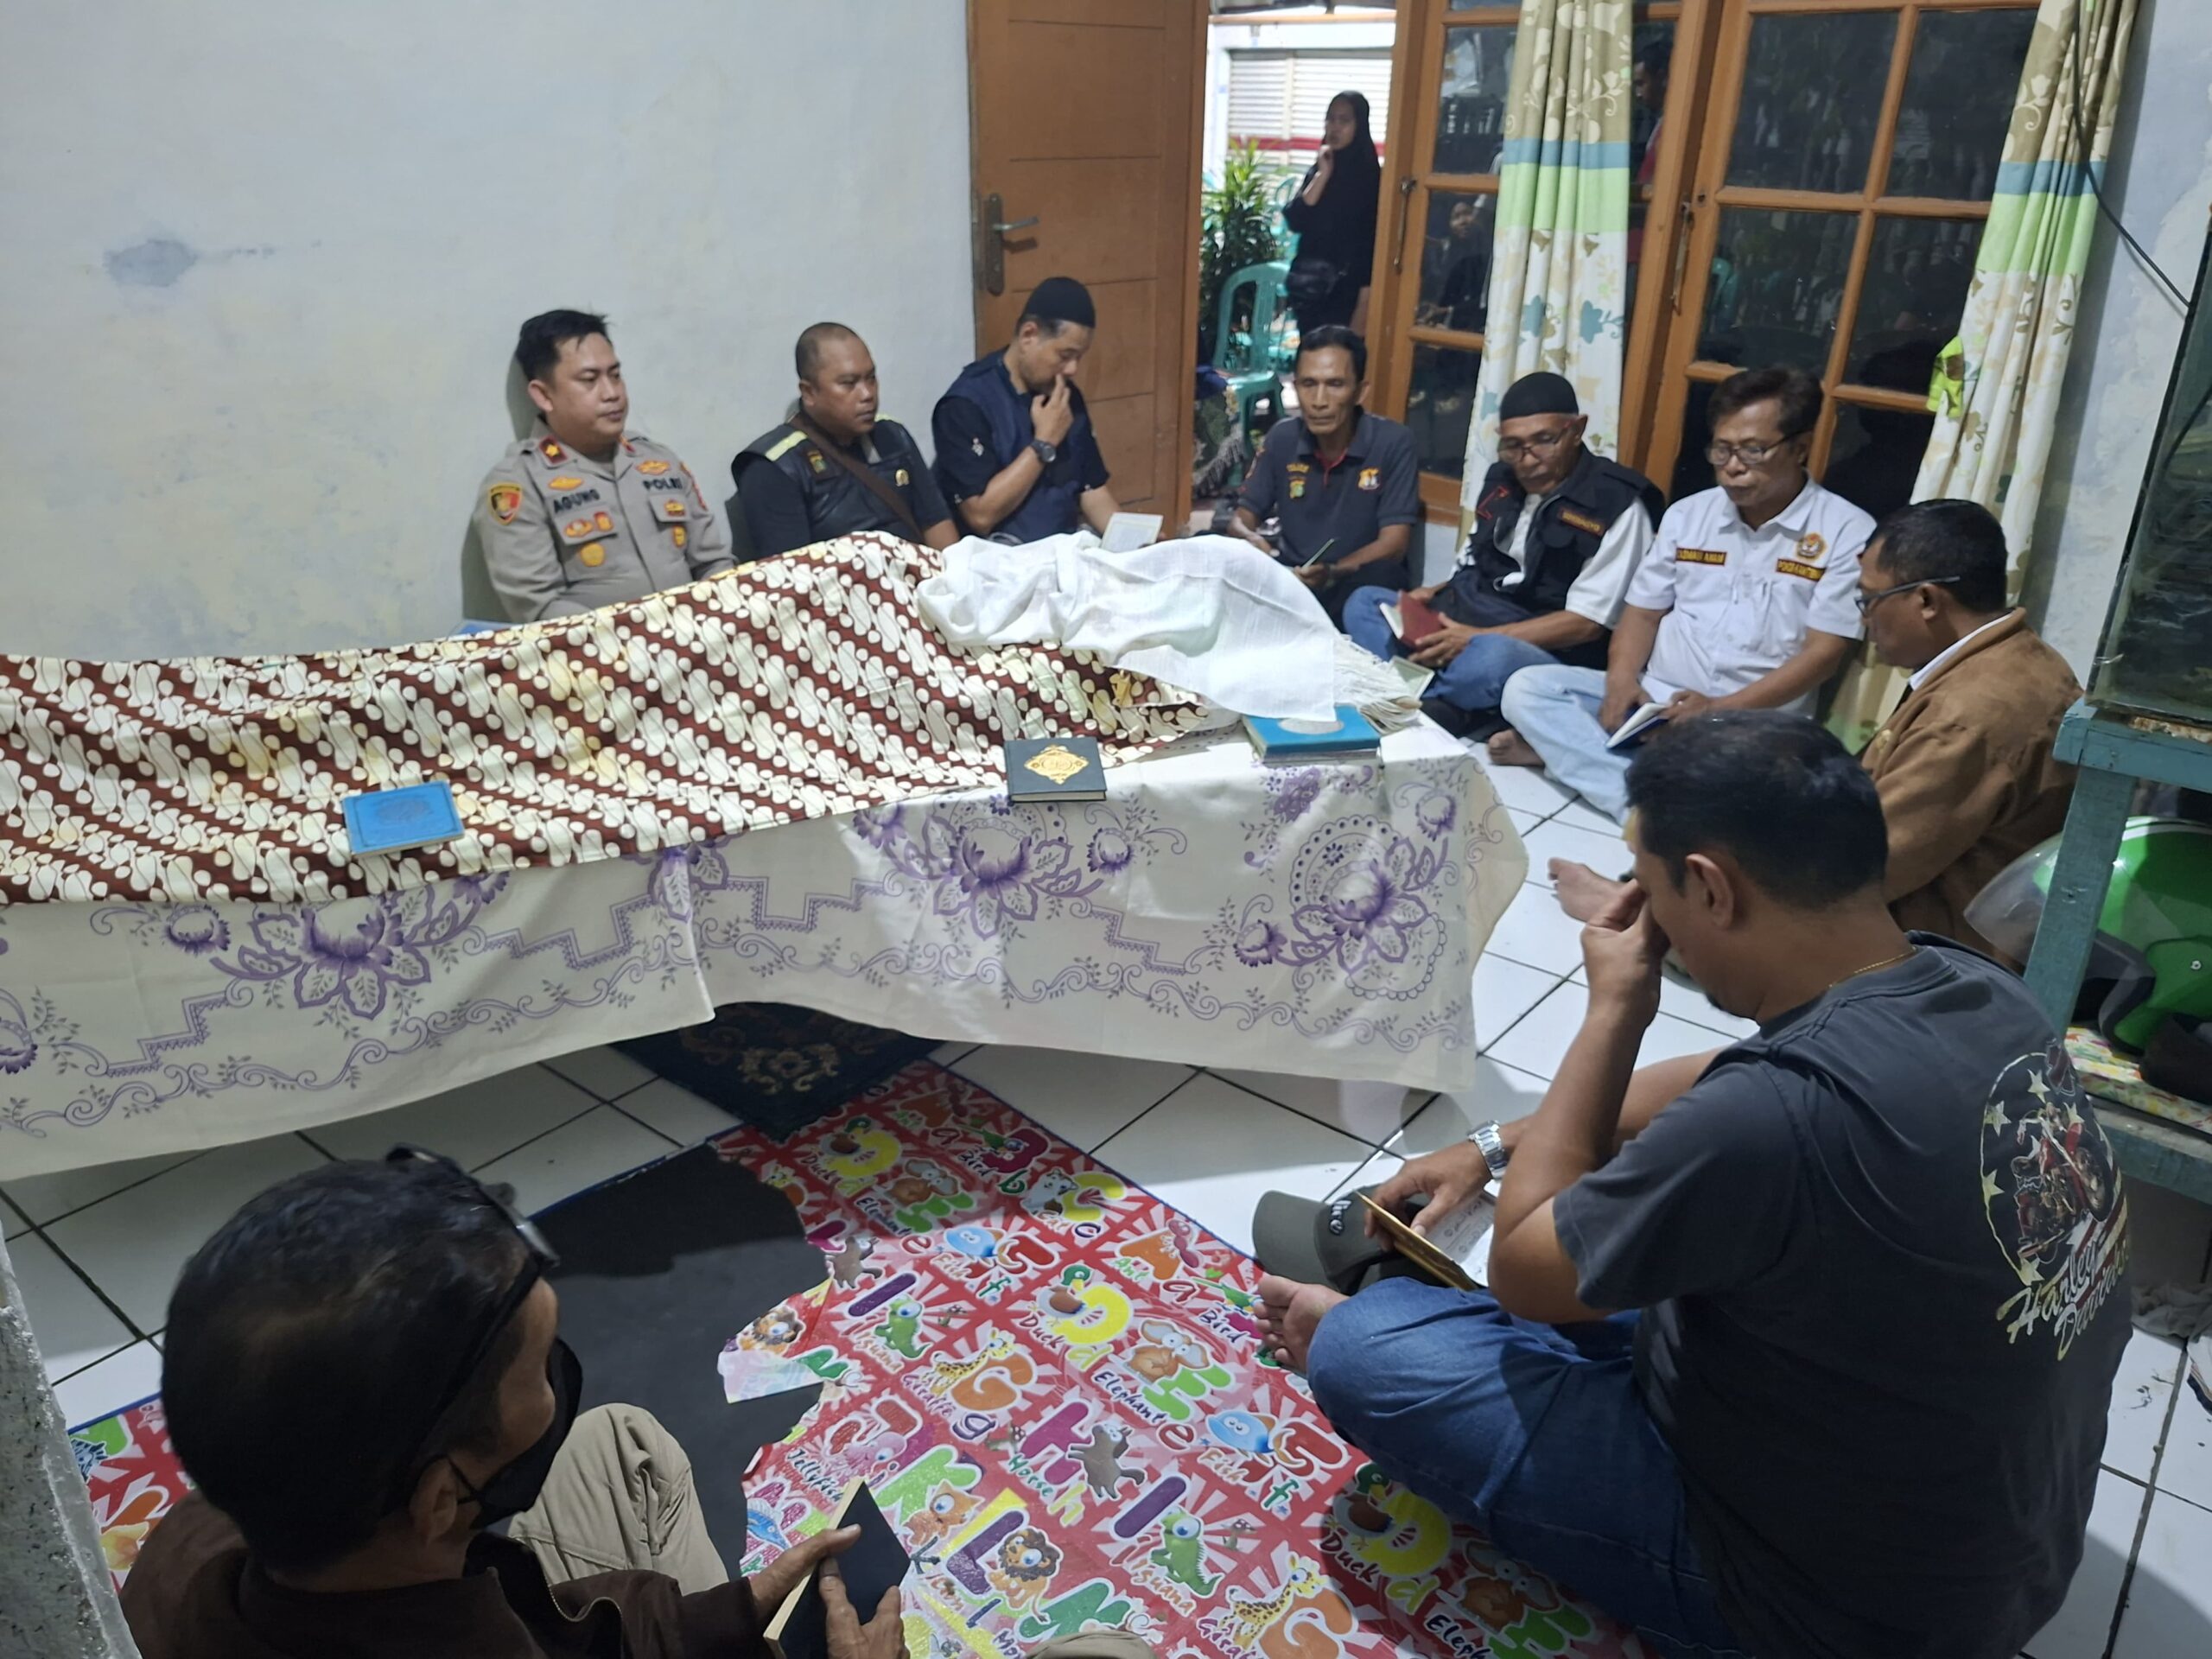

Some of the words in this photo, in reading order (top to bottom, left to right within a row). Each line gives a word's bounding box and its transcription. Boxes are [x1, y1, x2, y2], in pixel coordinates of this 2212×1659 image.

[553, 488, 601, 514] AGUNG
[643, 477, 683, 491] POLRI
[800, 1154, 842, 1185] Duck
[957, 1150, 996, 1178] Bird
[855, 1197, 912, 1237] Elephant
[1114, 1257, 1150, 1282] Ant
[1019, 1314, 1065, 1349] Duck
[1200, 1311, 1246, 1344] Bird
[902, 1374, 957, 1417] Giraffe
[1094, 1370, 1166, 1425] Elephant
[1008, 1454, 1054, 1497] Horse
[1201, 1449, 1249, 1483] Fish
[1319, 1532, 1381, 1584] Duck
